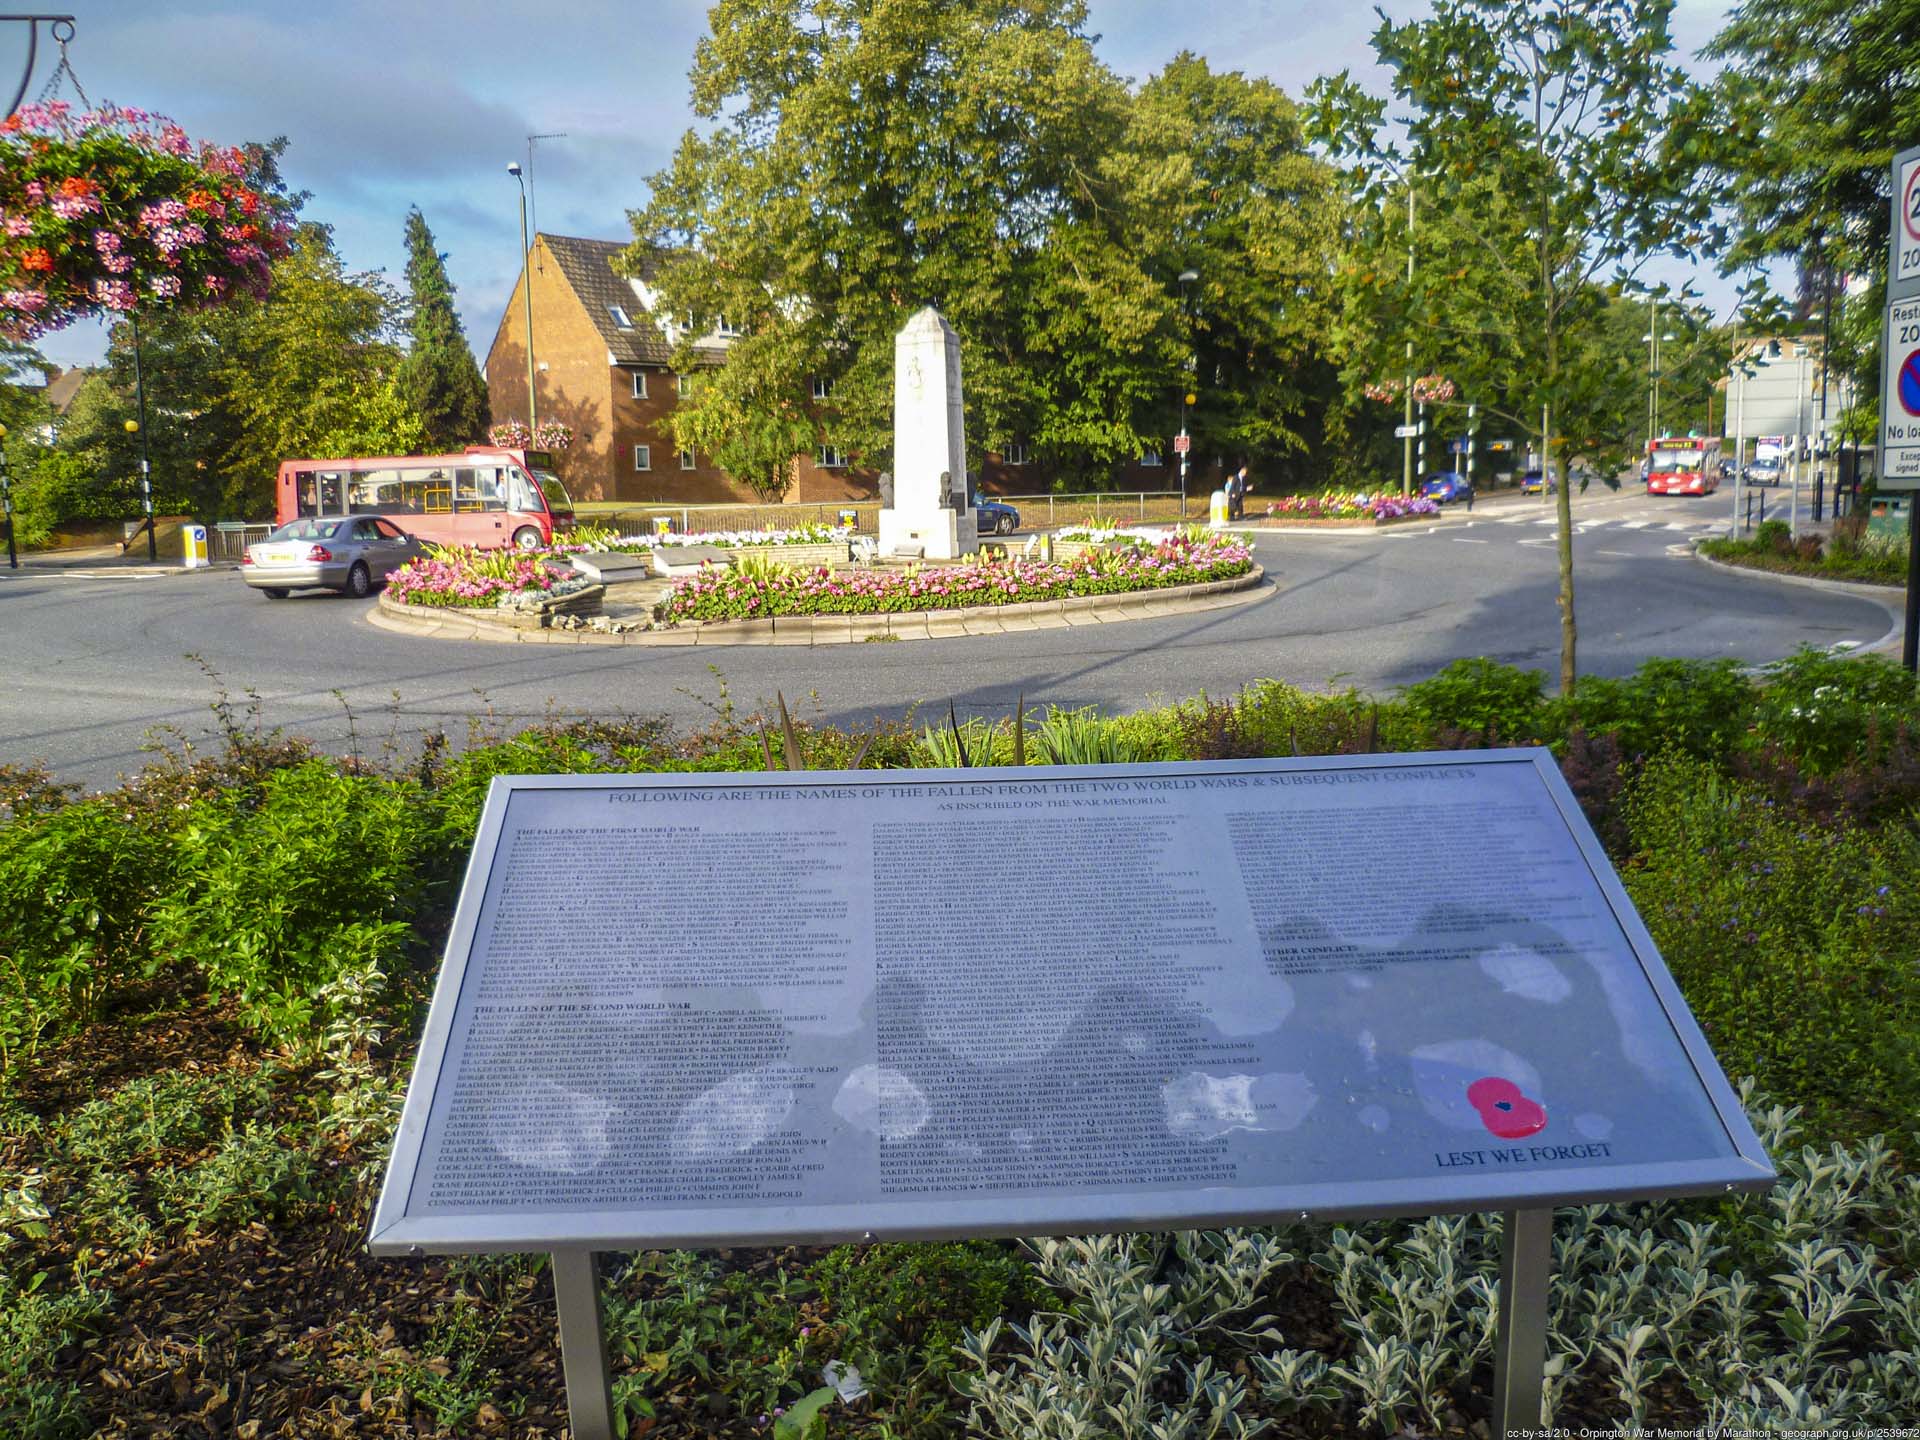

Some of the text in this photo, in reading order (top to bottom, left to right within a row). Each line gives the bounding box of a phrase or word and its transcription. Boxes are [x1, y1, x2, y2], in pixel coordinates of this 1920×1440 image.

[1910, 187, 1920, 219] 2
[1903, 249, 1920, 270] ZO
[1892, 305, 1920, 322] Rest
[1900, 324, 1920, 344] ZO
[1888, 425, 1903, 439] No
[1900, 451, 1920, 462] Excep
[1895, 463, 1919, 474] signed
[608, 769, 1478, 803] FOLLOWING ARE THE NAMES OF THE FALLEN FROM THE TWO WORLD WARS & SUBSEQUENT CONFLICTS
[956, 801, 1022, 810] INSCRIBED
[1103, 797, 1168, 806] MEMORIAL
[1433, 1143, 1613, 1166] LEST WE FORGET
